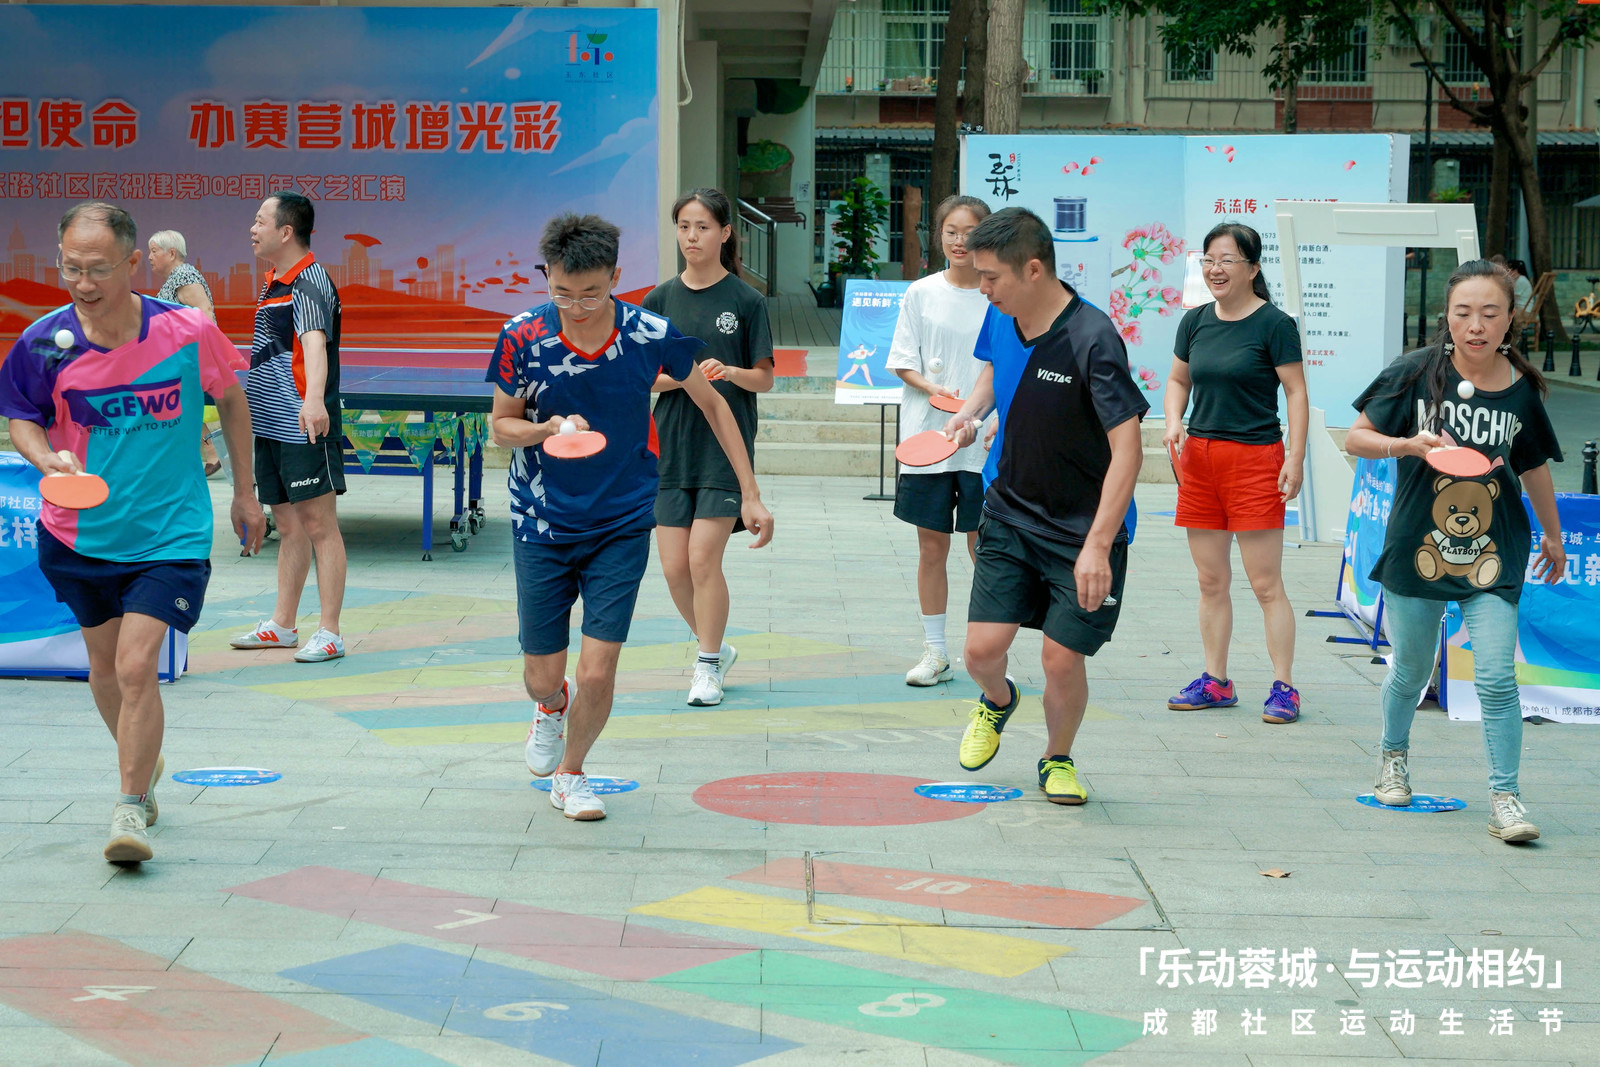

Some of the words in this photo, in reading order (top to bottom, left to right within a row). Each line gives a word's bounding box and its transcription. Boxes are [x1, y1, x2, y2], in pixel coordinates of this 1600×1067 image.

[188, 101, 561, 151] 办赛营城增光彩
[0, 172, 406, 201] 路社区庆祝建党102周年文艺汇演
[1037, 368, 1073, 384] VICTAS
[101, 388, 180, 418] GEWO
[87, 426, 121, 437] BETTER
[145, 422, 159, 432] TO
[290, 477, 321, 488] andro
[1441, 545, 1480, 556] PLAYBOY
[895, 877, 972, 896] 10
[433, 908, 502, 930] 7
[483, 1001, 570, 1022] 6
[857, 992, 947, 1018] 8
